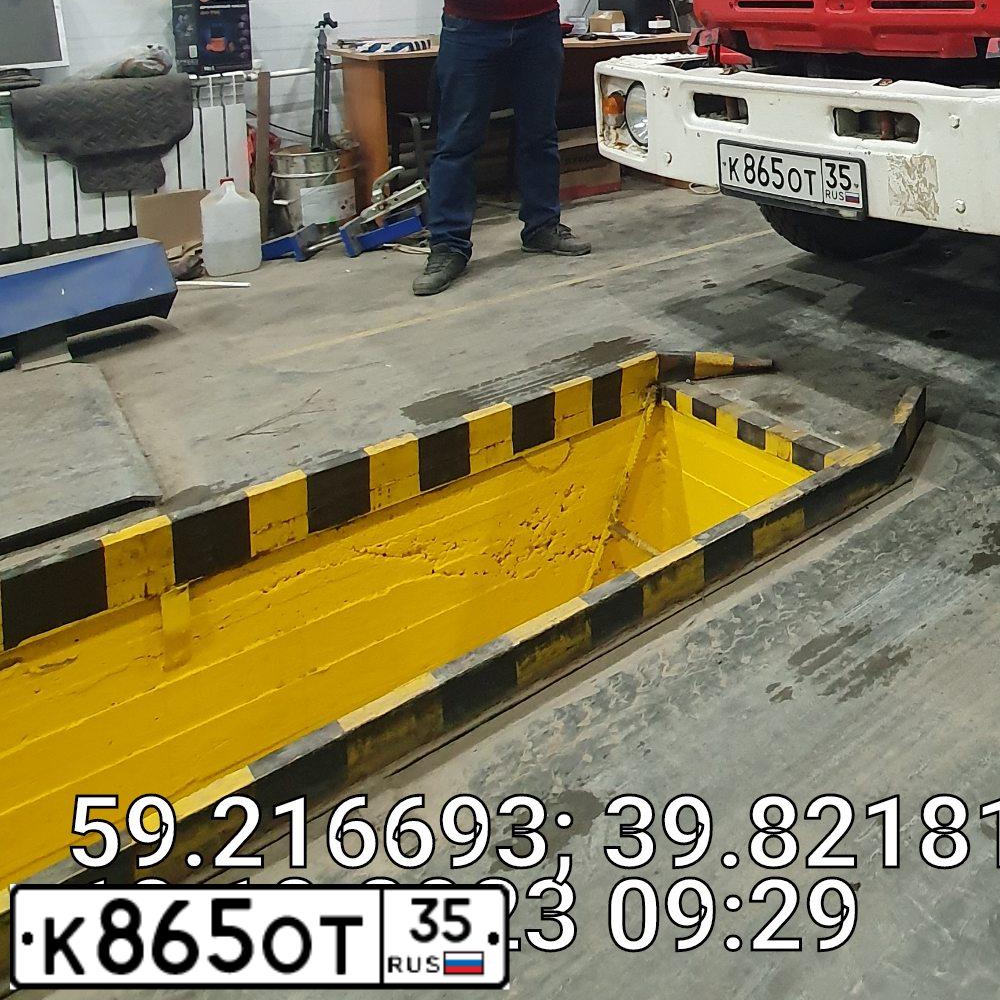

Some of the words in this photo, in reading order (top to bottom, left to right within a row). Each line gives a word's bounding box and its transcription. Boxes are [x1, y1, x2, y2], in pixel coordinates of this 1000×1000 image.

[728, 153, 816, 195] К865ОТ
[824, 162, 852, 191] 35
[825, 189, 845, 201] RUS
